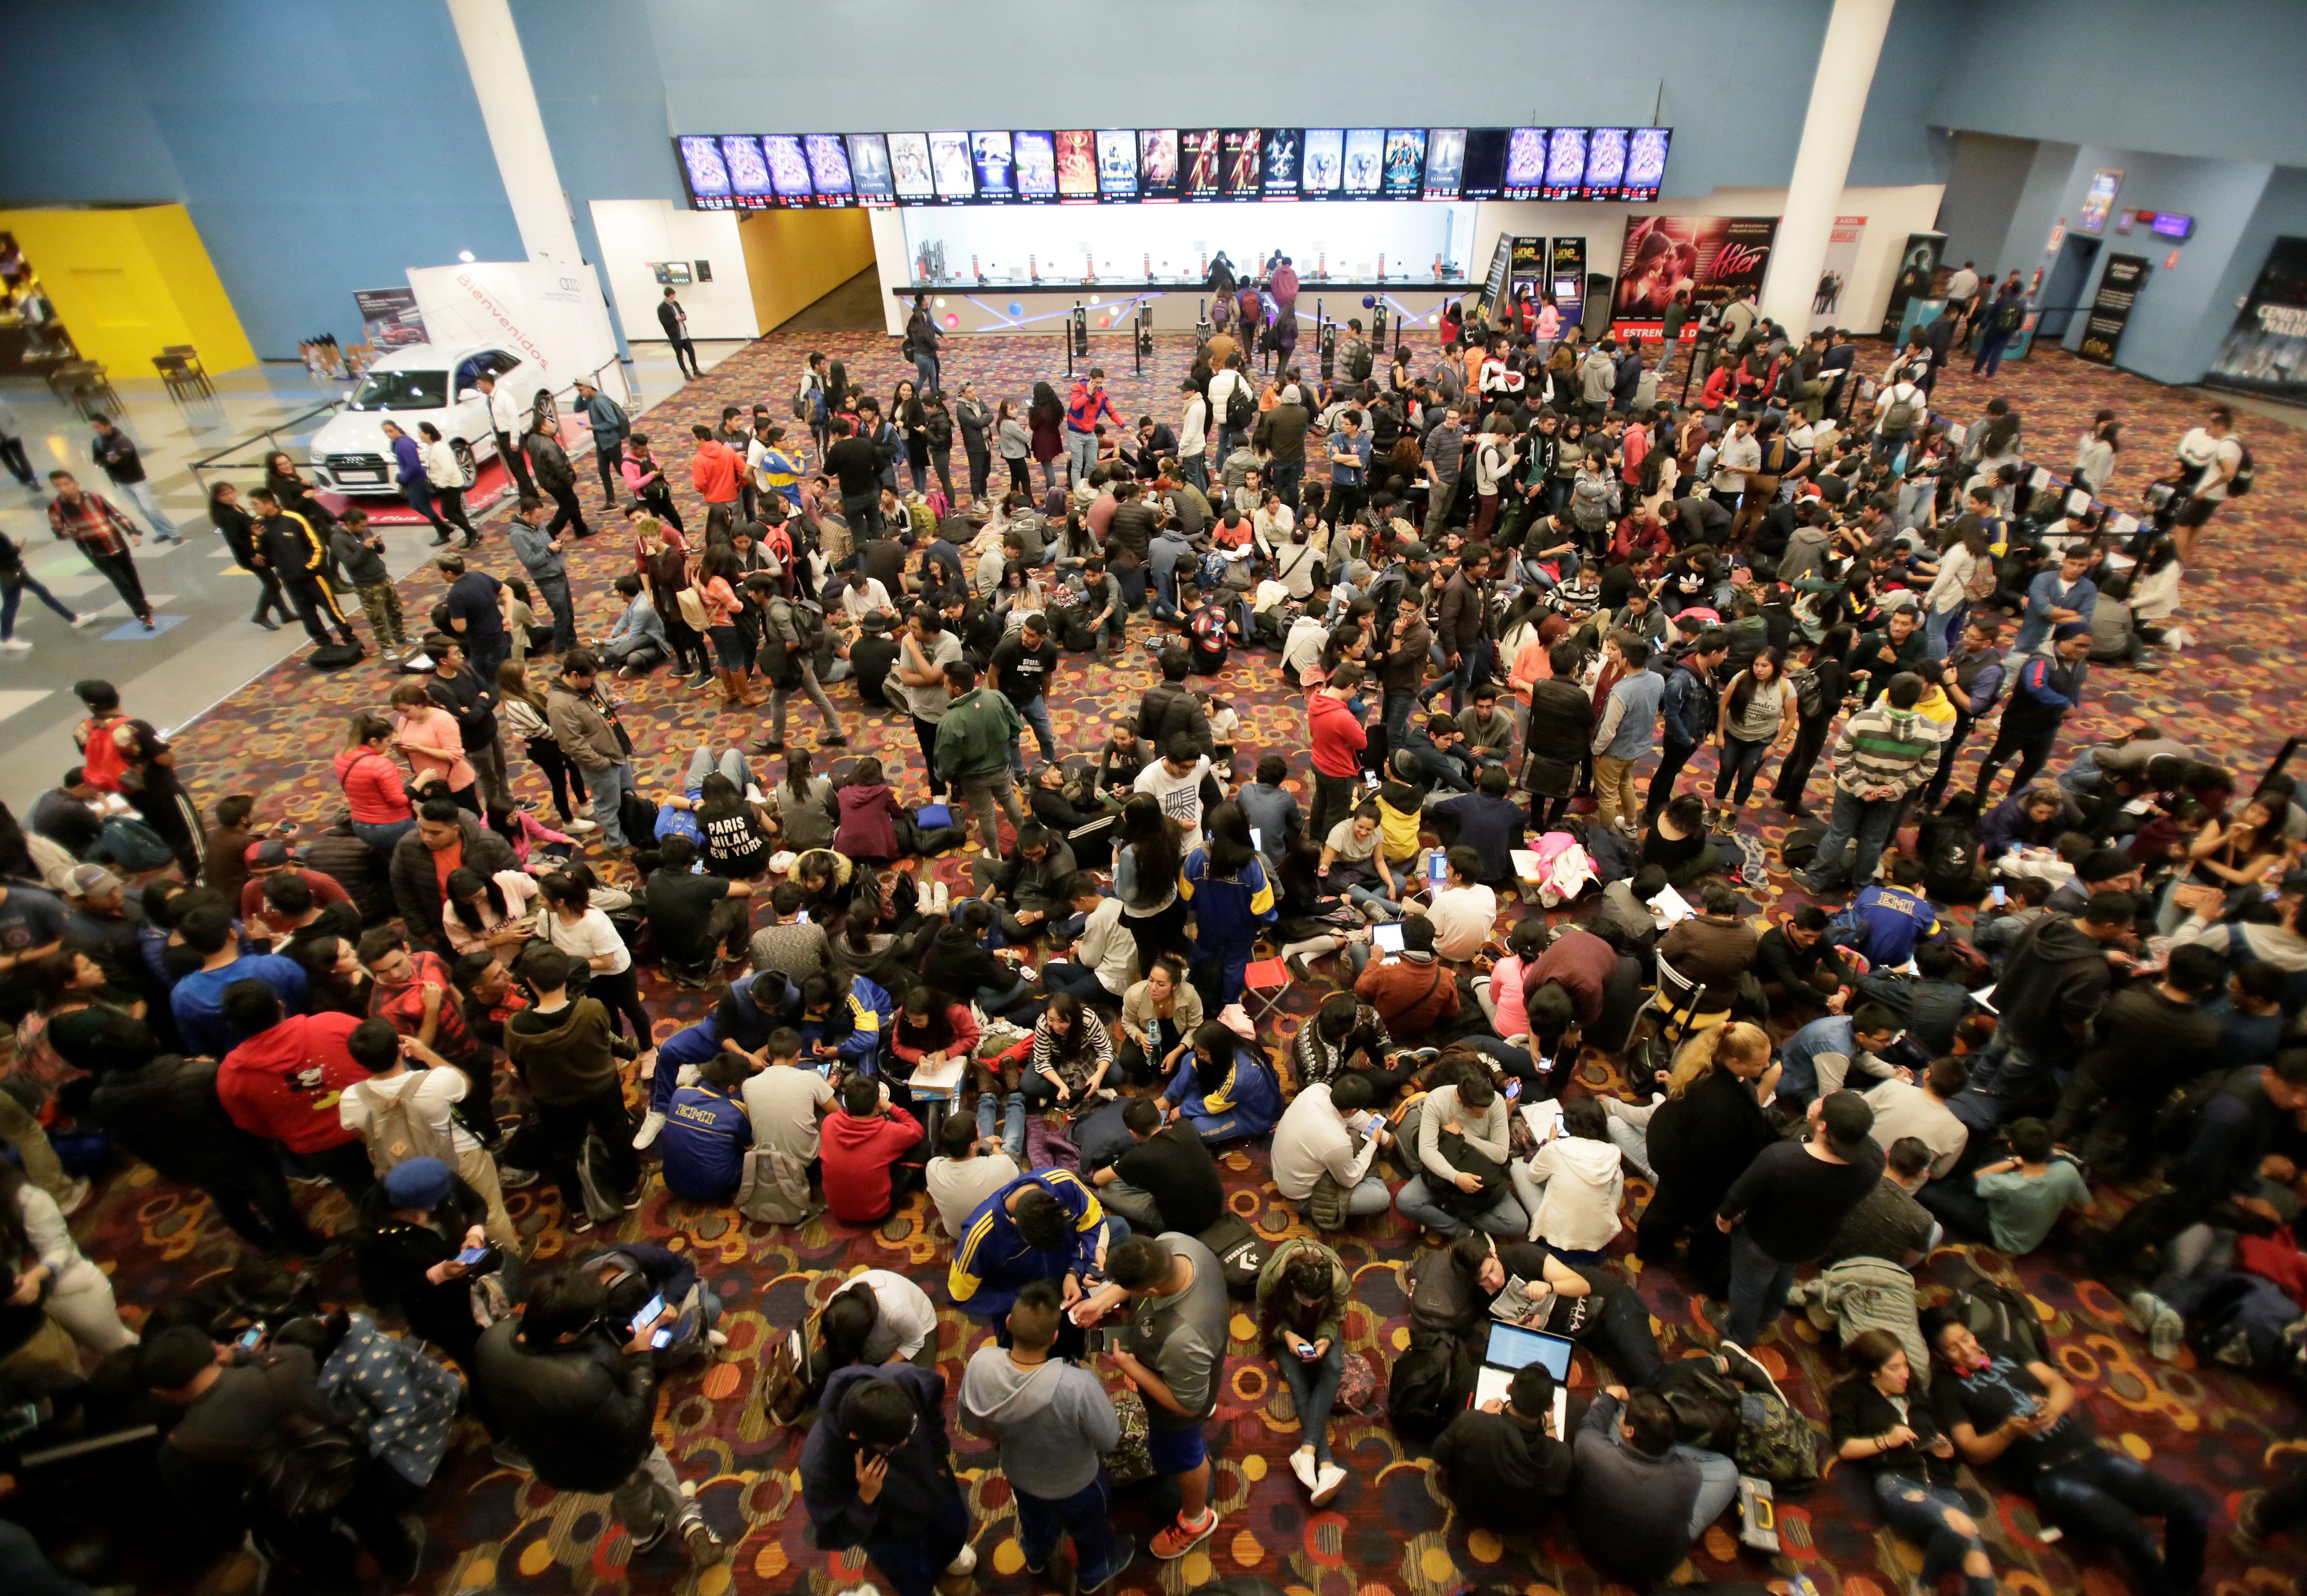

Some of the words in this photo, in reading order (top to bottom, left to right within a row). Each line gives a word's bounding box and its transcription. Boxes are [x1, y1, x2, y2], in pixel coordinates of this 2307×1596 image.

[1830, 231, 1856, 241] AMILIA
[457, 273, 549, 369] Bienvenidos
[708, 816, 745, 835] PARIS
[711, 829, 750, 847] MILAN
[732, 836, 762, 857] YORK
[1878, 892, 1915, 915] EMI
[489, 915, 517, 934] FROM
[675, 1103, 716, 1125] EMI
[1223, 1241, 1256, 1264] CONVERSE
